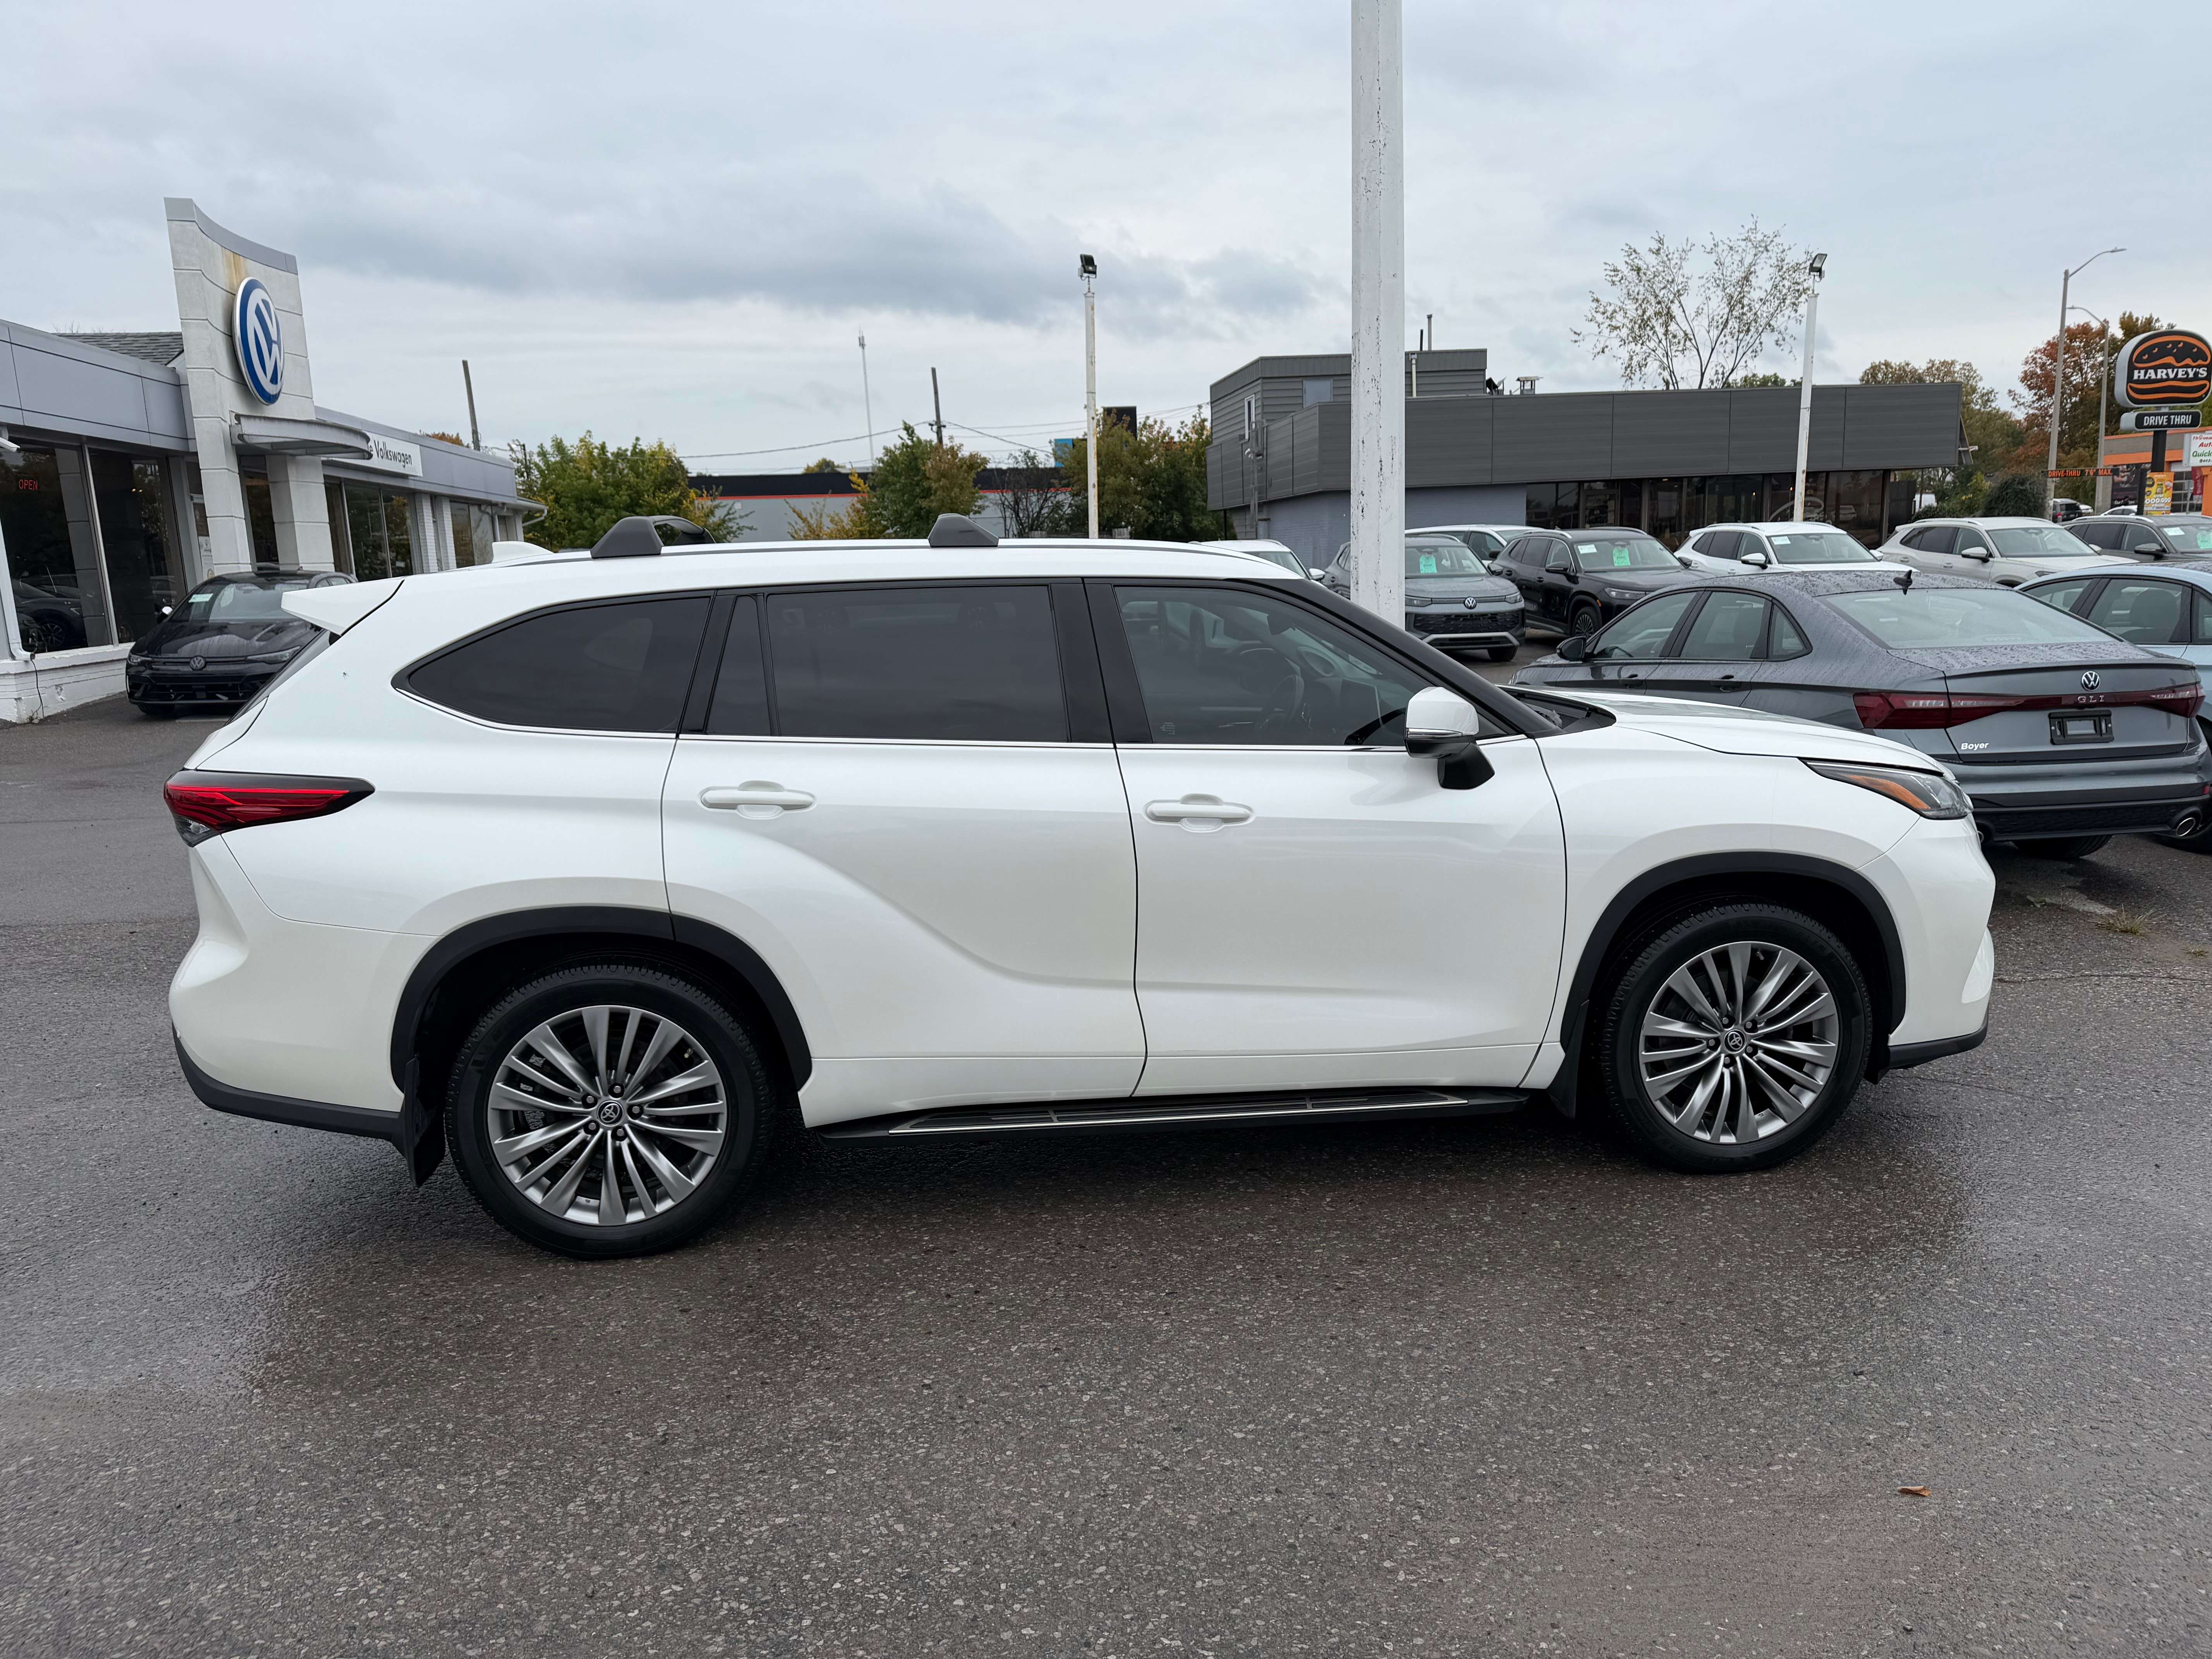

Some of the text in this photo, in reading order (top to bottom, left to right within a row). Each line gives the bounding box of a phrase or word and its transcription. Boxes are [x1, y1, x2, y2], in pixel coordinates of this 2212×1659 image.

[2133, 368, 2207, 380] HARVEY'S
[2143, 415, 2192, 426] DRIVE THRU
[374, 440, 412, 468] Volkswagen
[19, 479, 38, 489] OPEN
